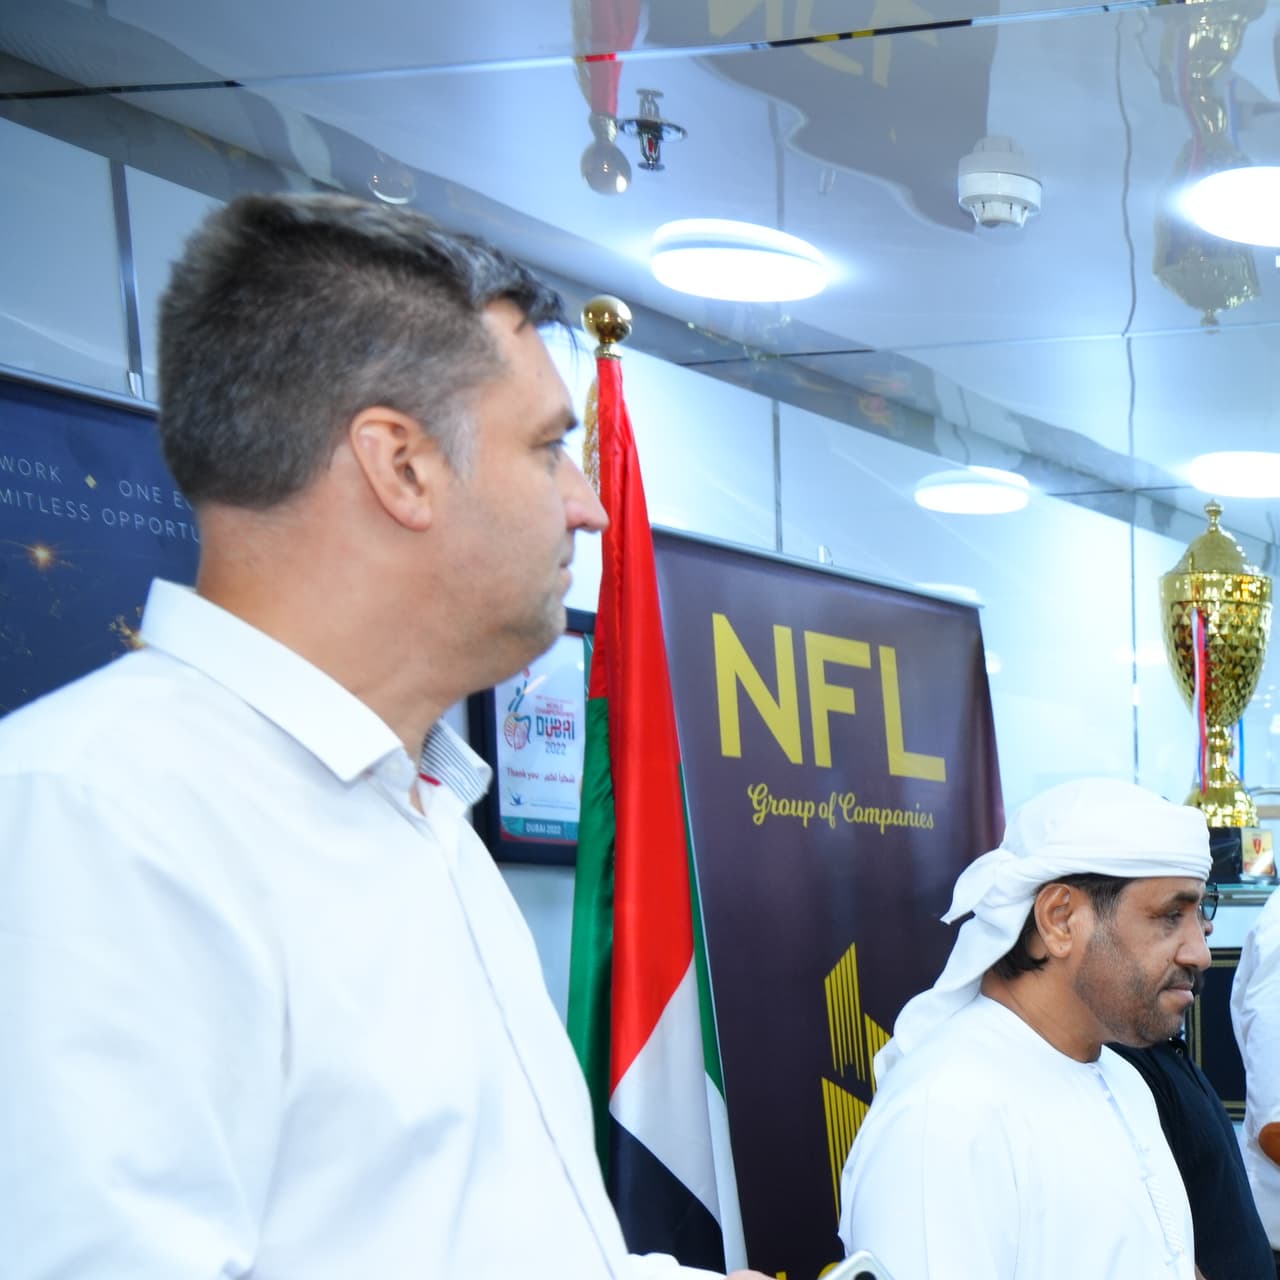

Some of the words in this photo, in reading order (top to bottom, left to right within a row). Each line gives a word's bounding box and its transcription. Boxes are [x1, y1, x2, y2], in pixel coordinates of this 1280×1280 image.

[118, 479, 162, 505] ONE
[712, 612, 947, 783] NFL
[747, 783, 816, 828] Group
[818, 792, 837, 829] of
[838, 792, 934, 835] Companies
